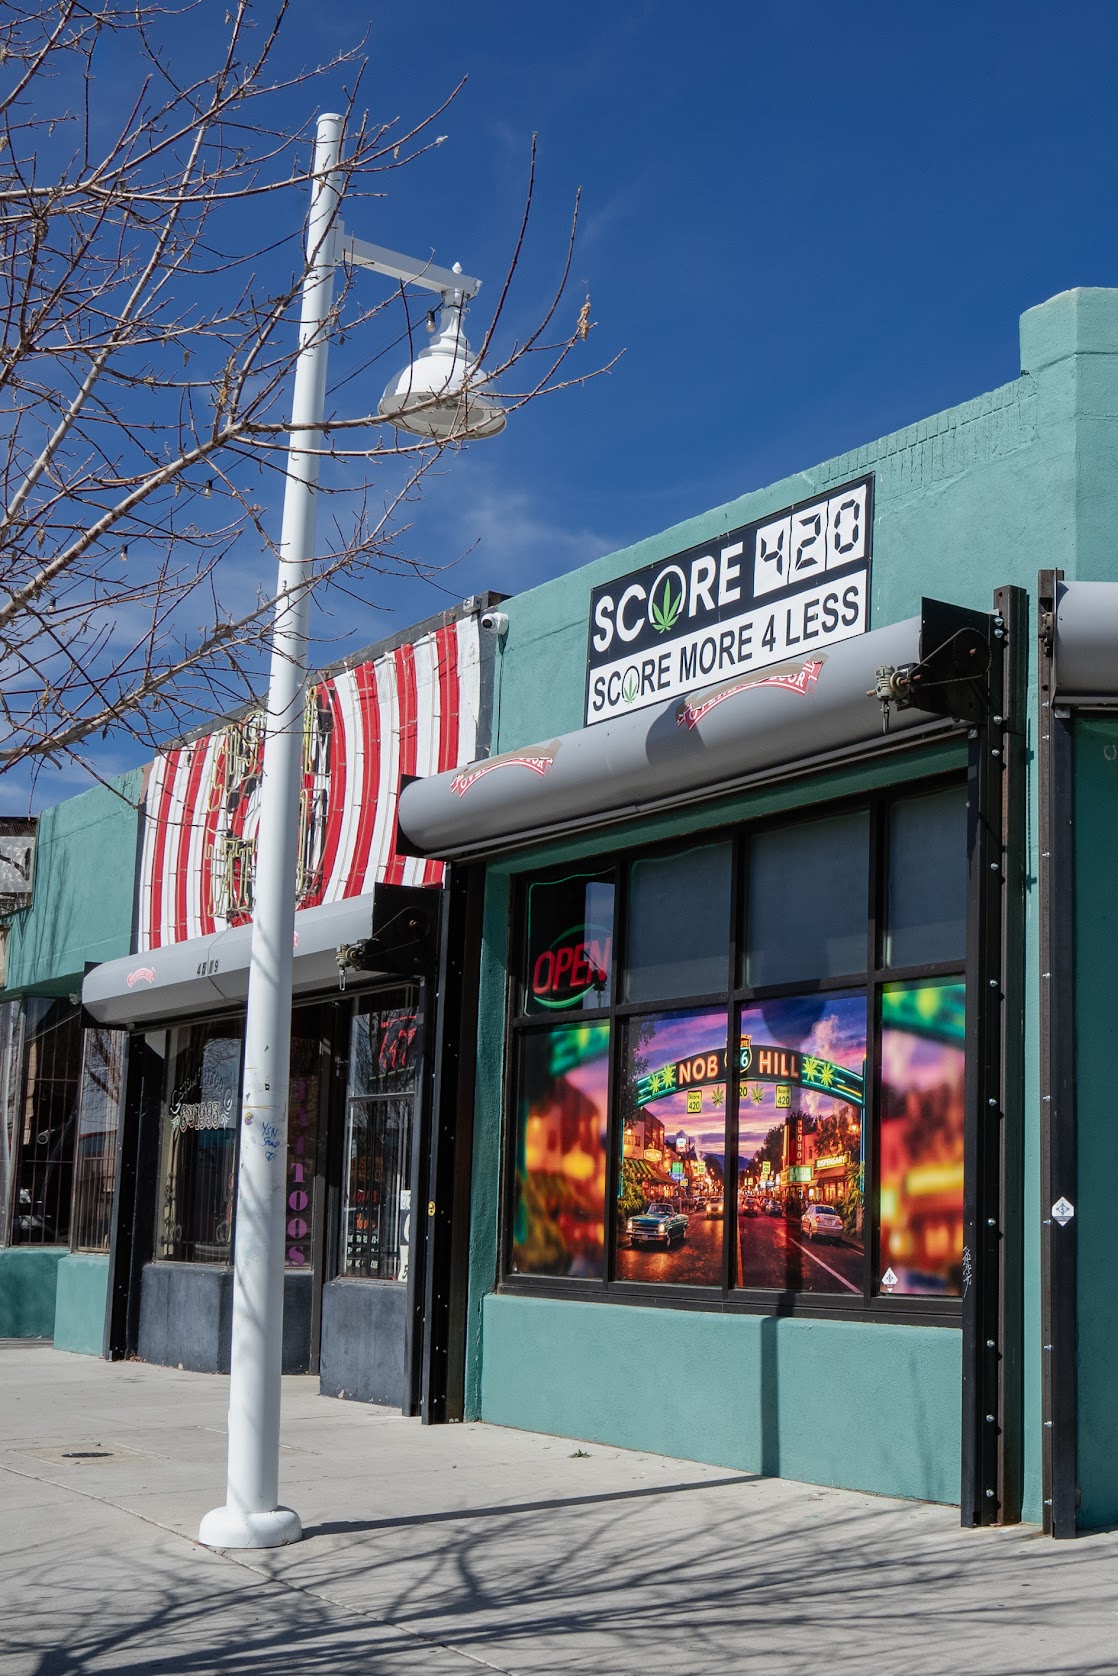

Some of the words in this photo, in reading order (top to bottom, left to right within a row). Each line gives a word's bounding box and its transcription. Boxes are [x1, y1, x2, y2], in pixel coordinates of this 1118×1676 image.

[592, 541, 745, 653] SCORE
[760, 498, 861, 577] 420
[592, 651, 672, 711] SCORE
[679, 622, 753, 683] MORE
[761, 614, 776, 653] 4
[786, 585, 860, 647] LESS
[532, 936, 611, 995] OPEN
[678, 1054, 719, 1084] NOB
[758, 1050, 799, 1079] HILL
[688, 1101, 700, 1110] 420
[777, 1096, 790, 1105] 420
[816, 1155, 845, 1168] DISPENSARY
